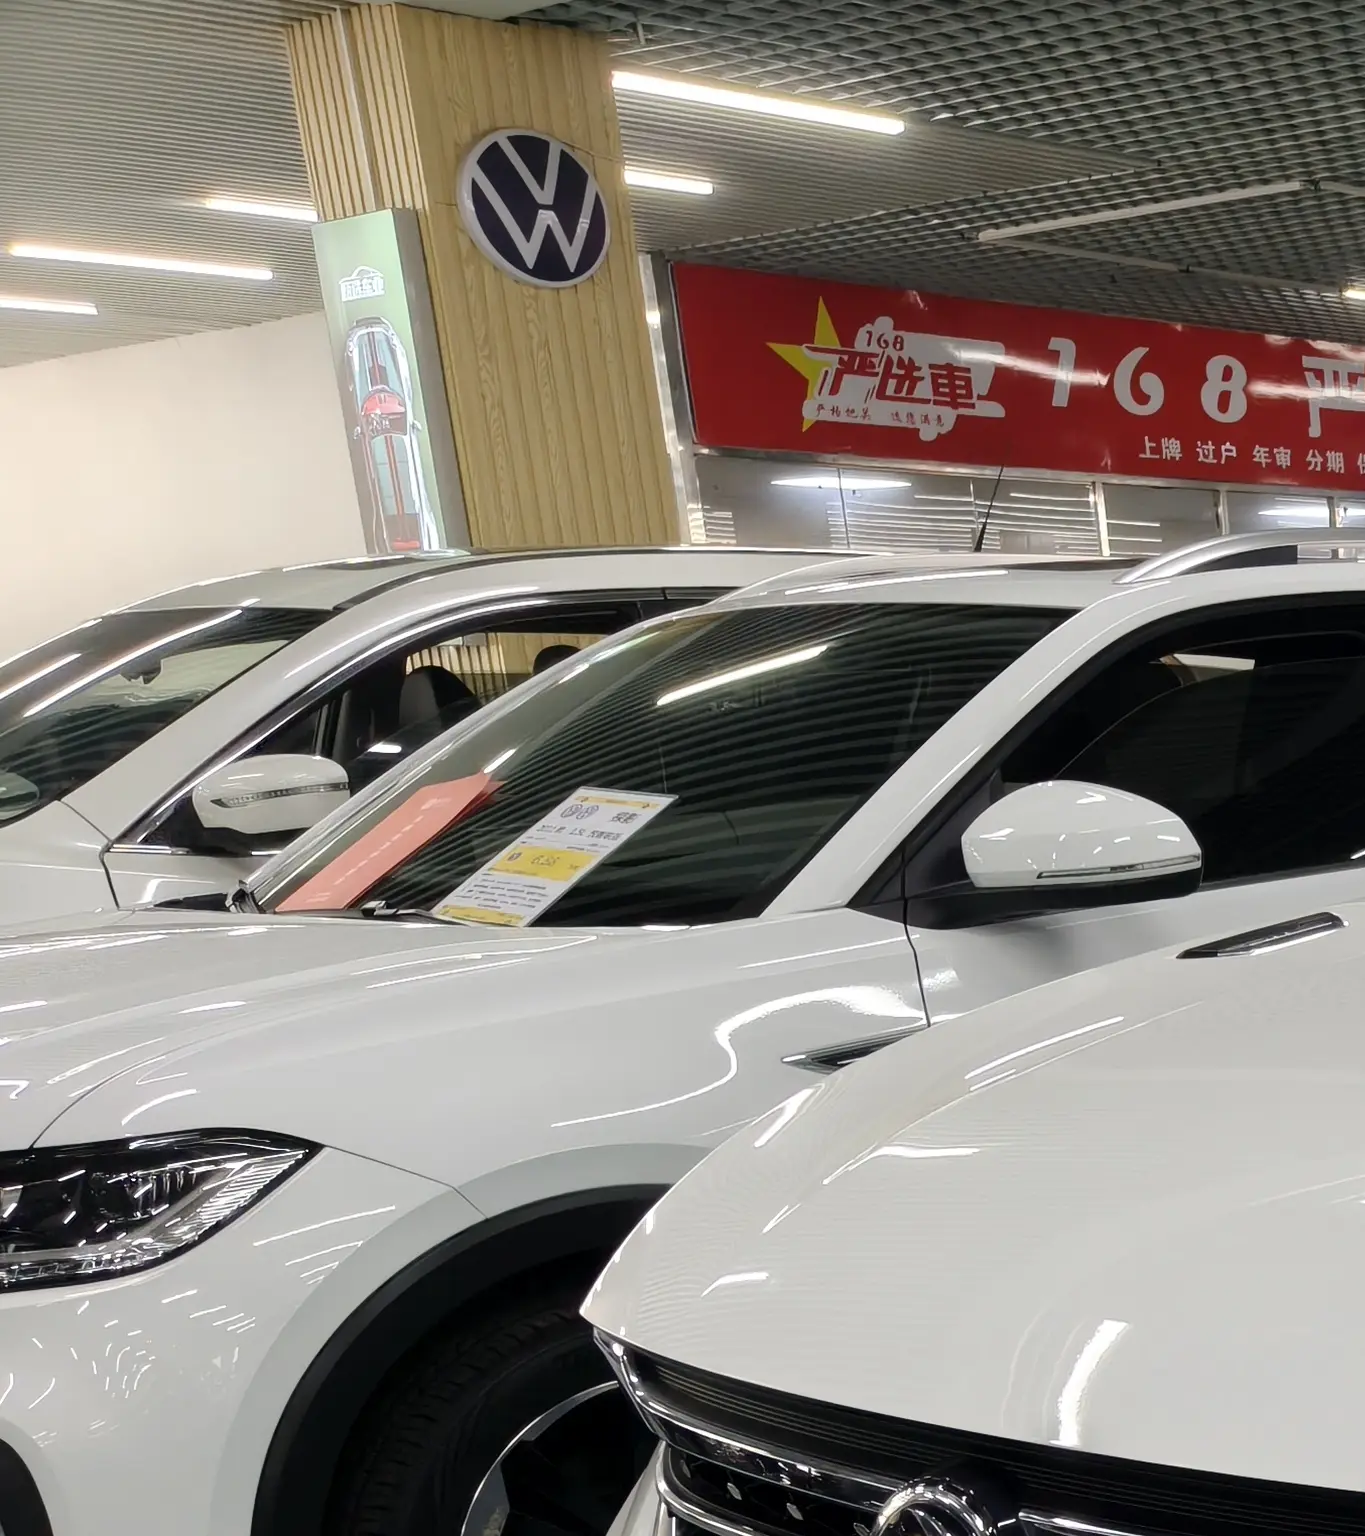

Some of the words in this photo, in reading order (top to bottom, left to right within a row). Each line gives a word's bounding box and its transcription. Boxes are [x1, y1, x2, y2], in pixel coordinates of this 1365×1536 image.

[865, 330, 905, 351] 168
[1138, 435, 1183, 462] 上牌
[1196, 440, 1238, 465] 过户
[1252, 444, 1292, 470] 年审
[1306, 449, 1345, 474] 分期
